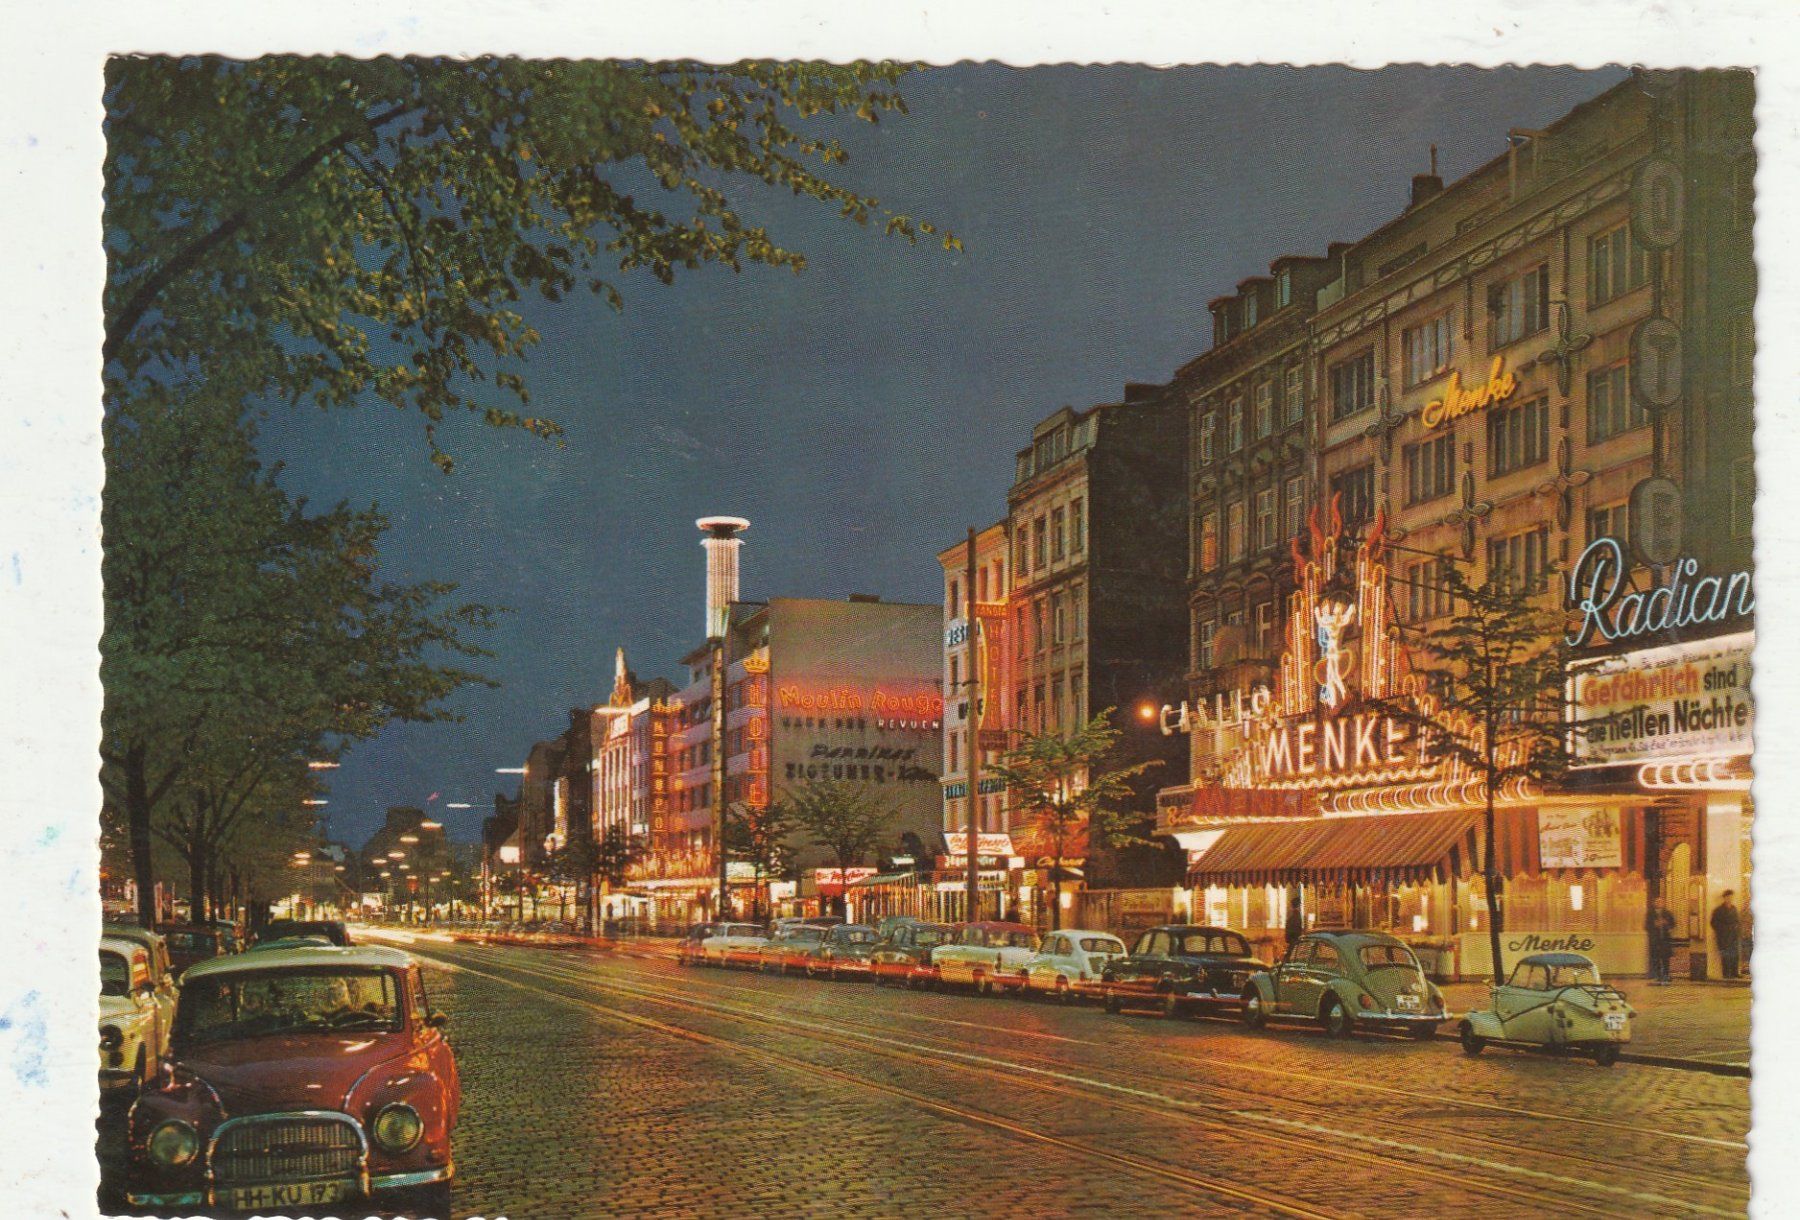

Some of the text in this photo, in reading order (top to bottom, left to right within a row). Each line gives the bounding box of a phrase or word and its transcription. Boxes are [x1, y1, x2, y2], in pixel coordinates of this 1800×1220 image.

[1421, 355, 1516, 428] Menke
[779, 685, 862, 709] Moulin
[871, 691, 943, 714] Rouge
[1582, 662, 1737, 707] Gefährlich sind
[878, 719, 940, 730] REVUEN
[1609, 705, 1670, 742] hellen
[1674, 695, 1748, 734] Nächte
[1260, 711, 1406, 778] MENKE
[1508, 934, 1595, 952] Menke
